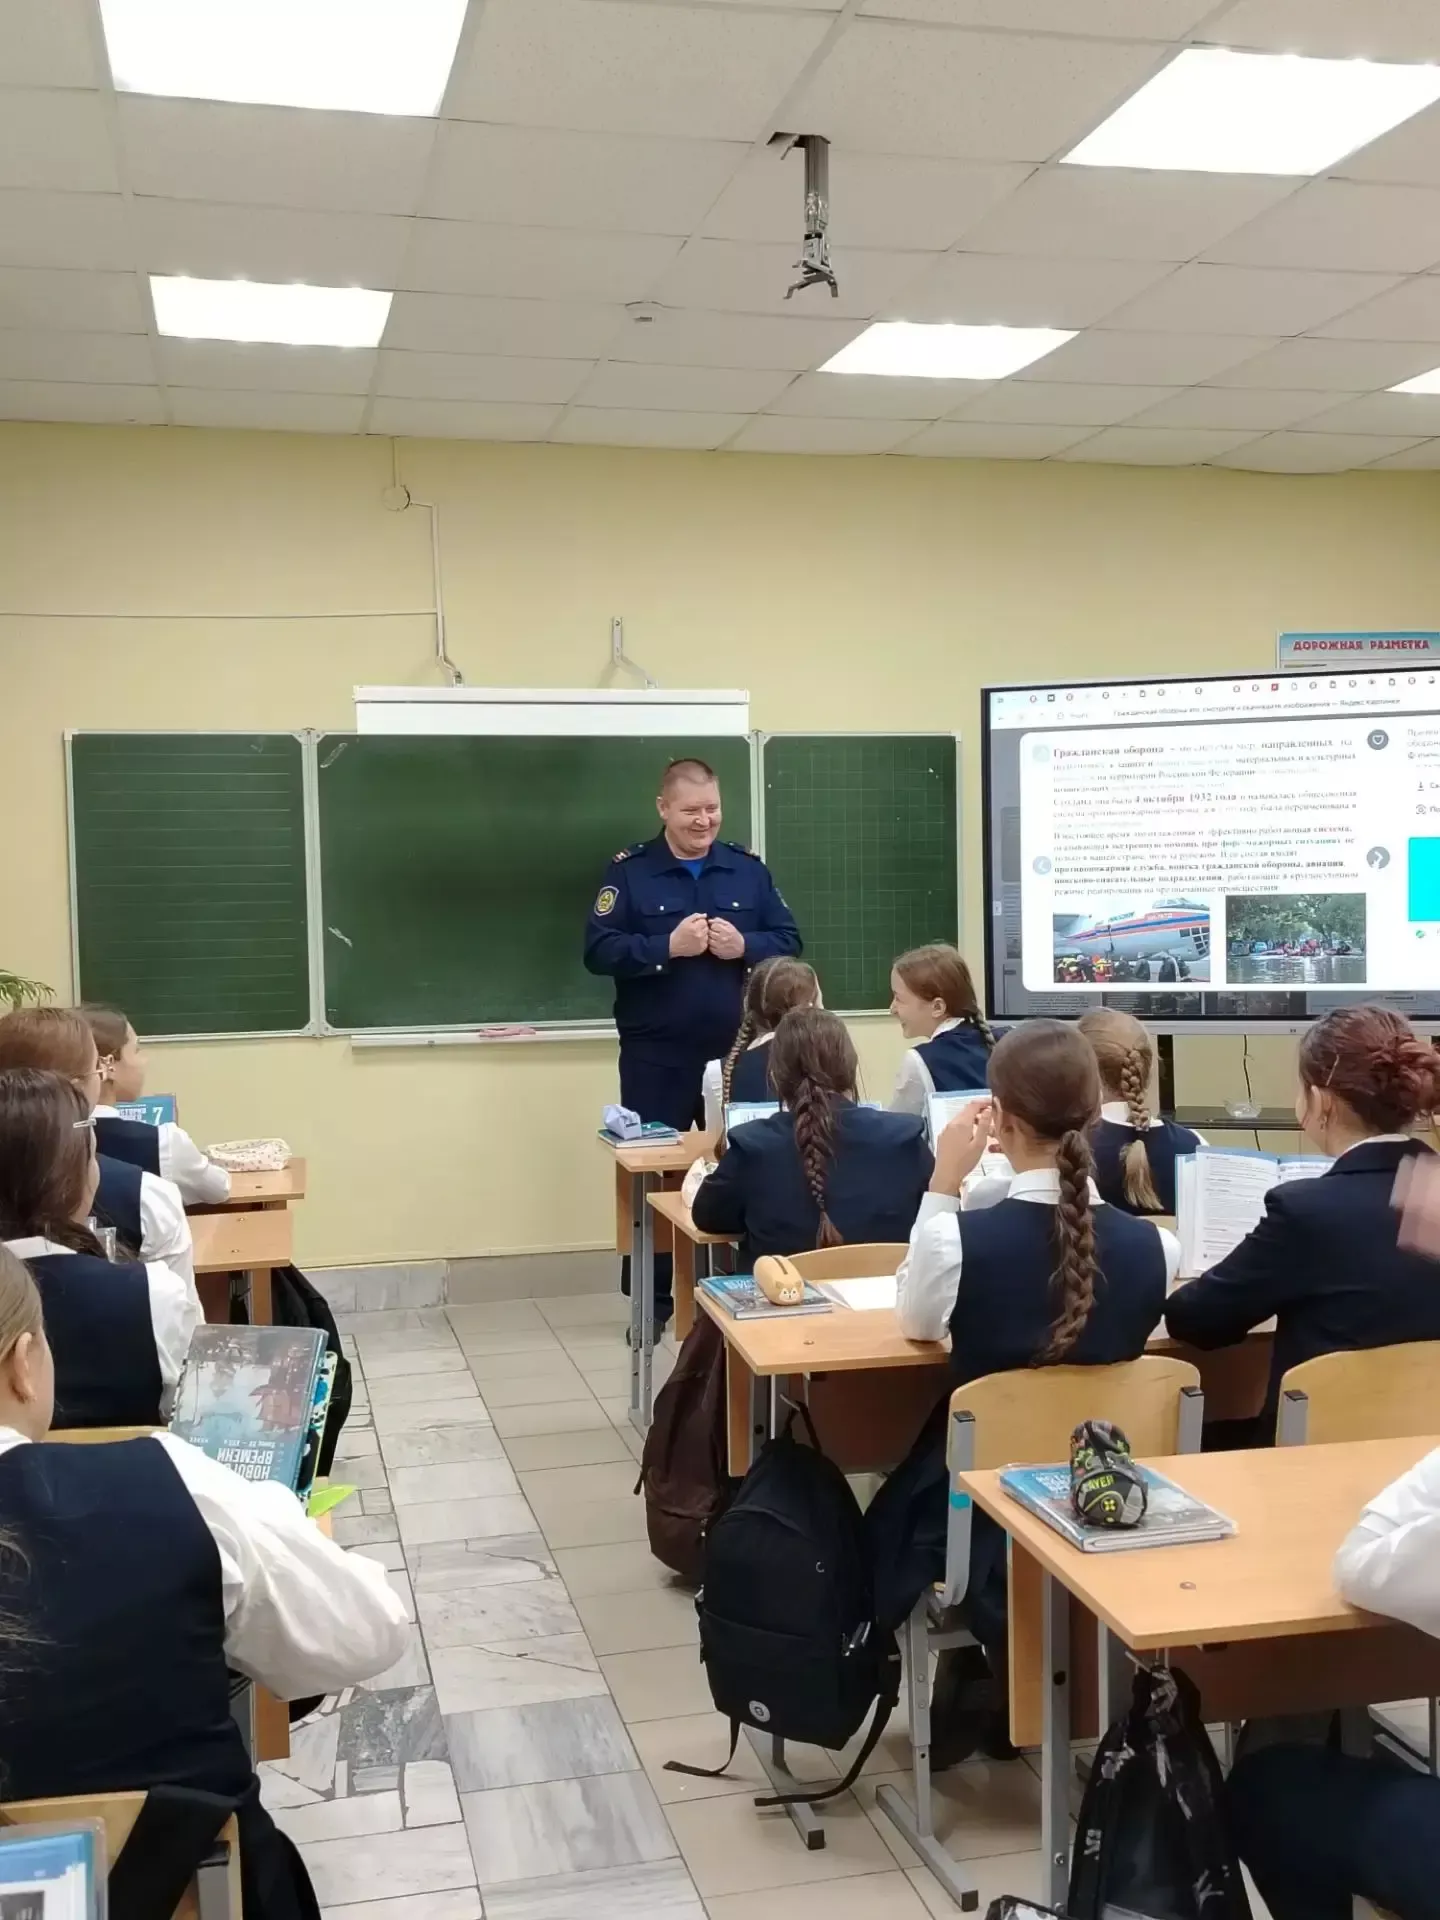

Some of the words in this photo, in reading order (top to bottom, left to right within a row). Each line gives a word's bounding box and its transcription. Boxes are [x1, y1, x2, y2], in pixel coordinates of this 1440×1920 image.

[1293, 640, 1363, 651] ДОРОЖНАЯ
[1369, 639, 1430, 650] РАЗМЕТКА
[1053, 747, 1120, 760] Гражданская
[1124, 744, 1164, 756] оборона
[1261, 739, 1333, 750] направленных
[152, 1106, 164, 1127] 7
[217, 1447, 274, 1464] ВРЕМЕНИ
